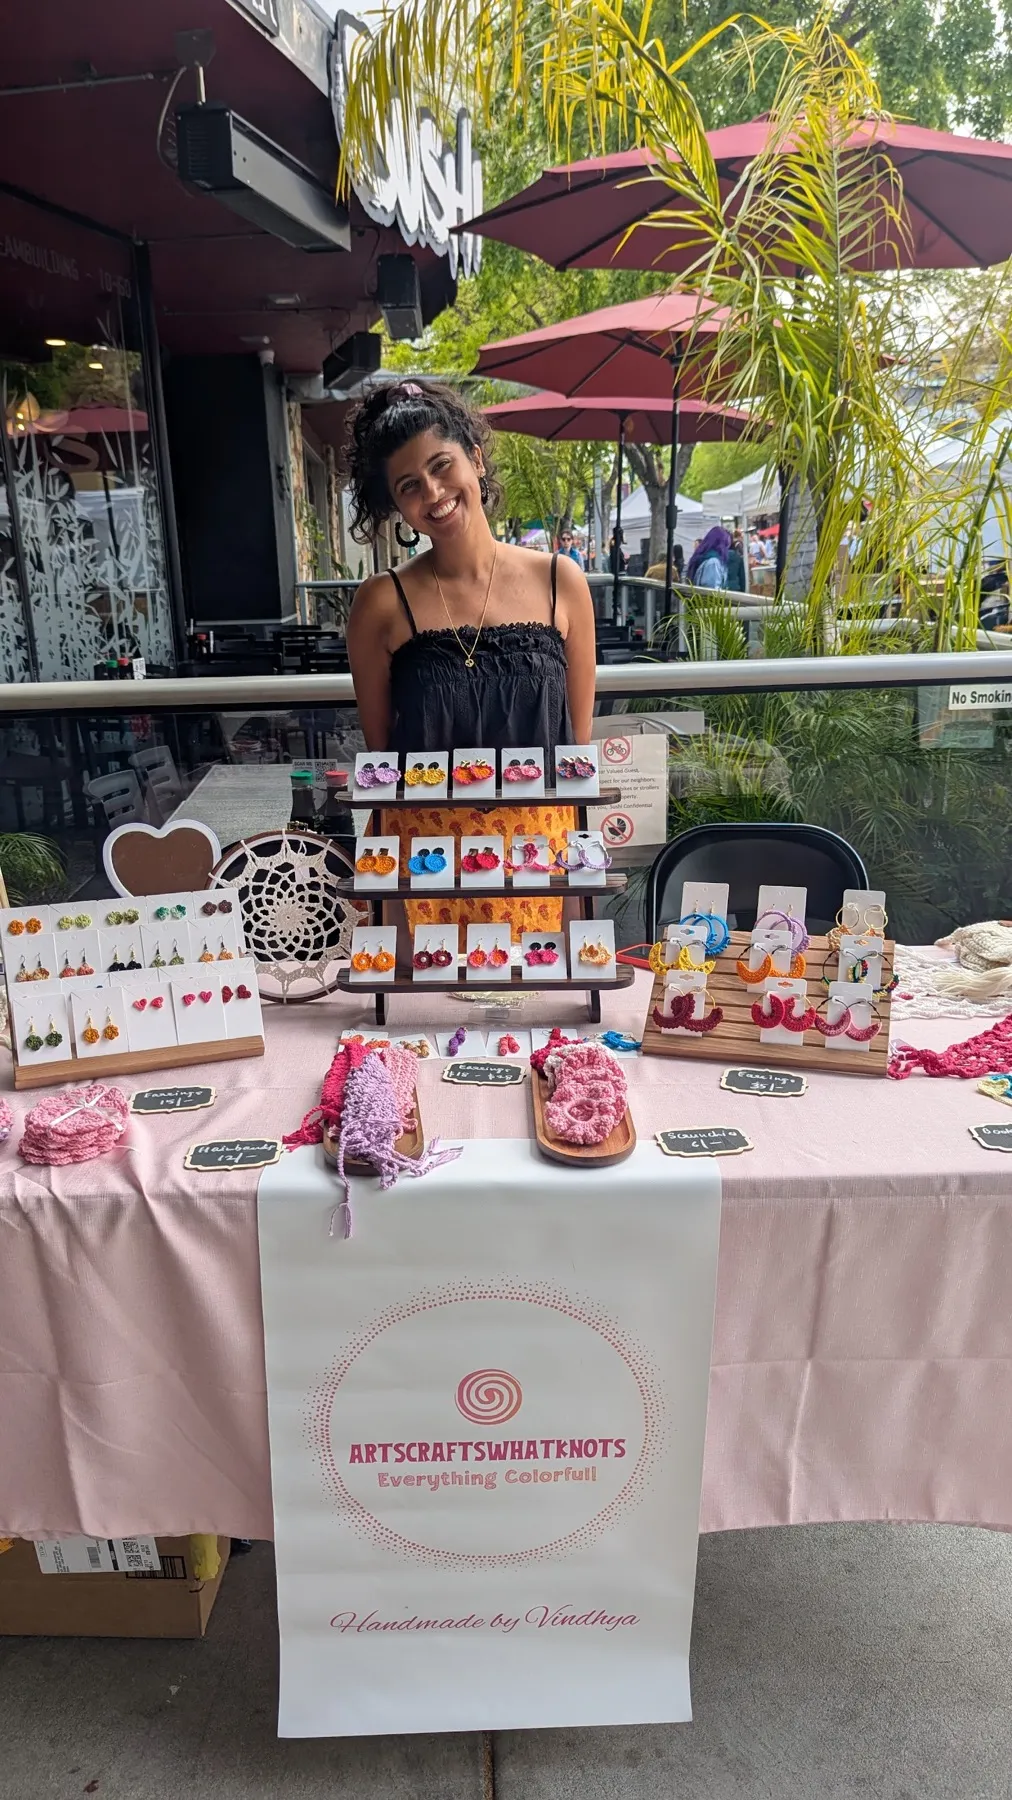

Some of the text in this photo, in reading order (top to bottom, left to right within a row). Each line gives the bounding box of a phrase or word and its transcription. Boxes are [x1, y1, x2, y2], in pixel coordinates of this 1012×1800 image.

[0, 236, 79, 281] EAMBUILDING
[952, 690, 1012, 704] No Smokin
[349, 1438, 627, 1464] ARTSCRAFTSWHATKNOTS
[377, 1470, 497, 1491] Everything
[329, 1604, 641, 1633] Handmade by Vindhya
